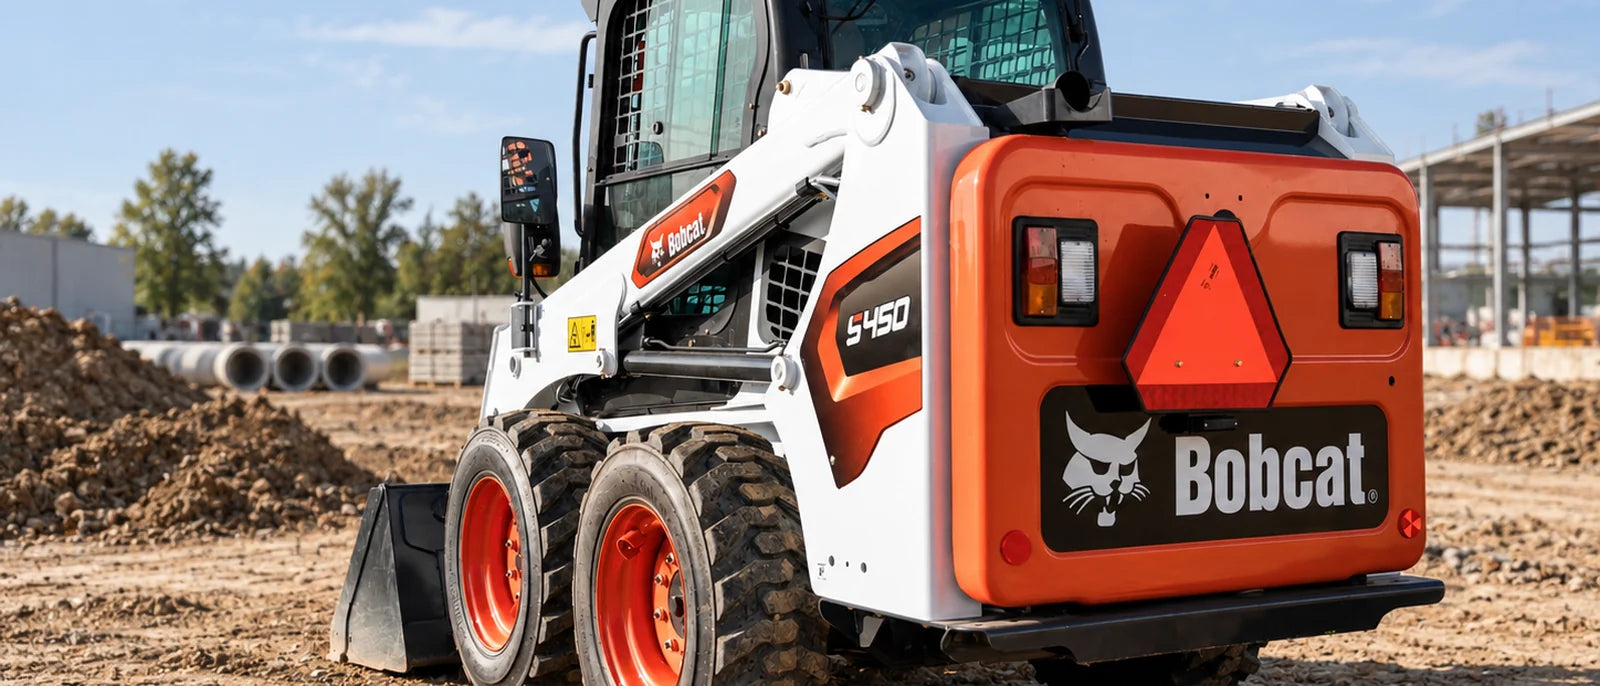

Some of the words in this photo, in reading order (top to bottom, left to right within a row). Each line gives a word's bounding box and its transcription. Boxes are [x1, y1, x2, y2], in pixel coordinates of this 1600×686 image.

[667, 212, 706, 258] Bobcat
[846, 295, 911, 347] S450
[1175, 432, 1366, 517] Bobcat
